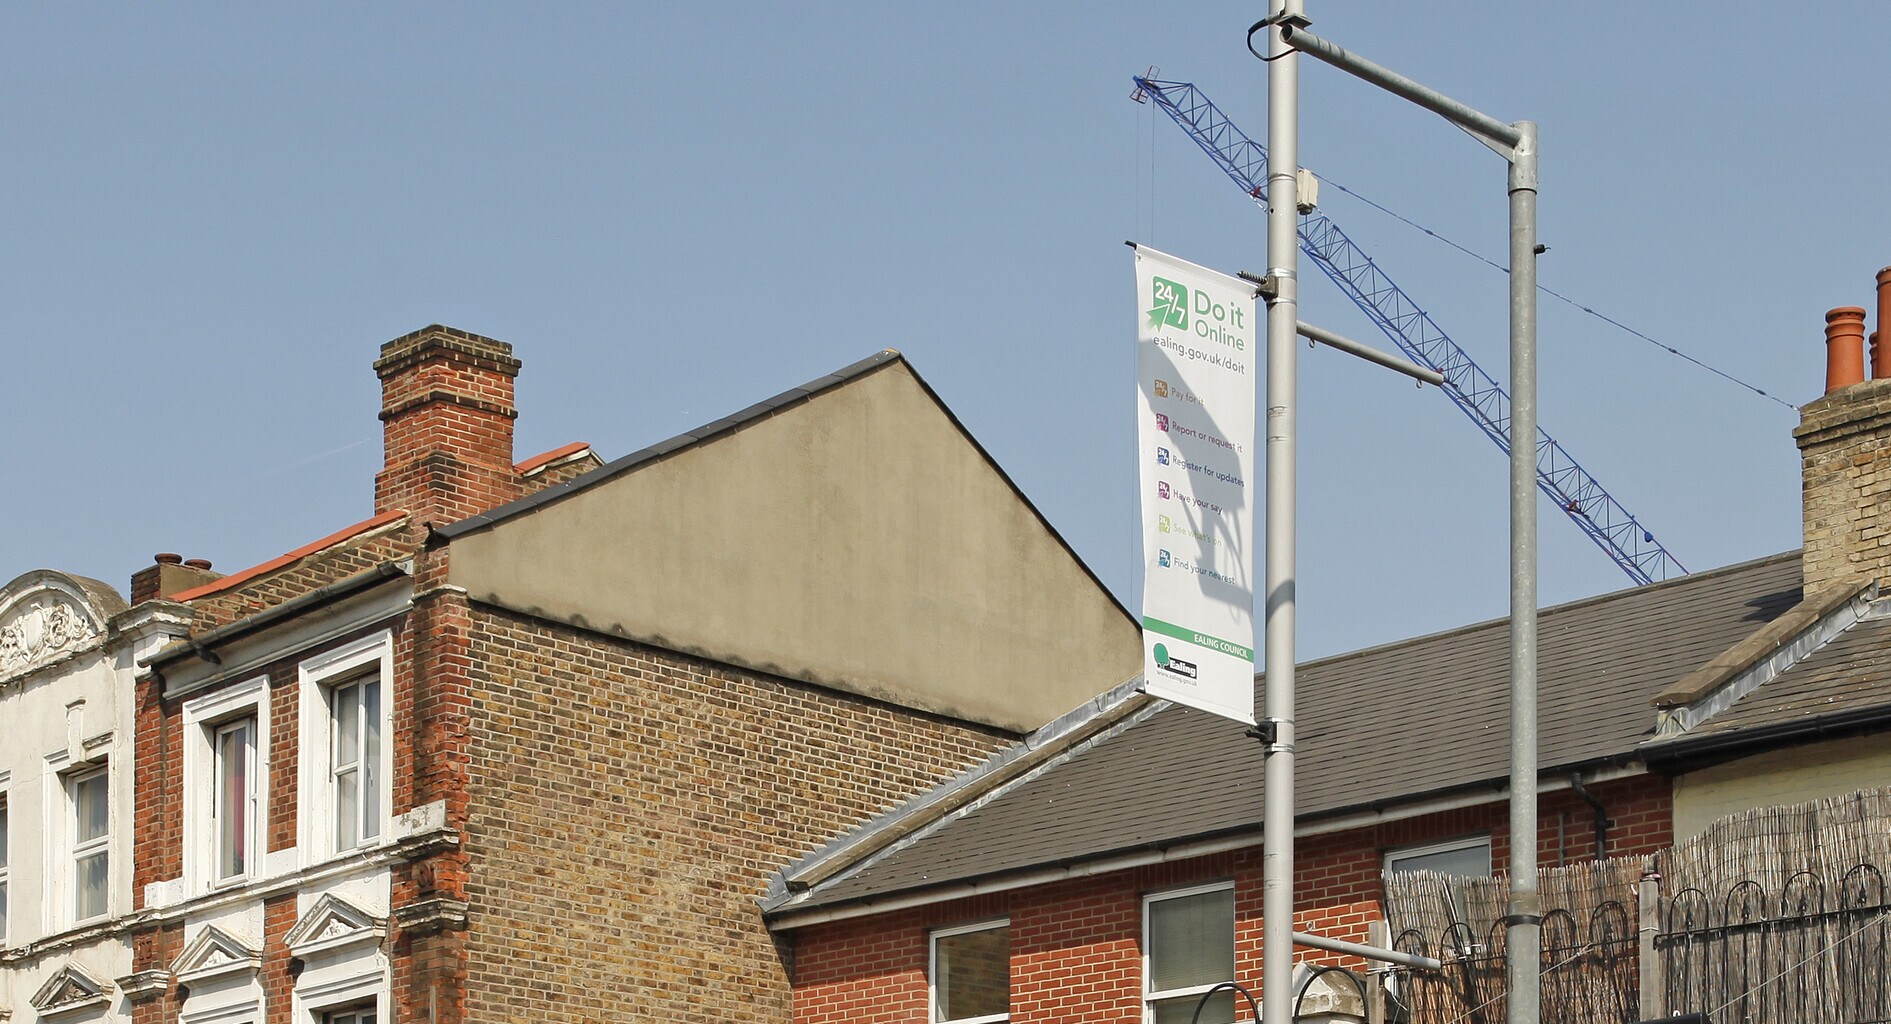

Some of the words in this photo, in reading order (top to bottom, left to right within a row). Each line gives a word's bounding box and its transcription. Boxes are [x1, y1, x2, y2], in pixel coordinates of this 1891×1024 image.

[1194, 288, 1226, 321] Do
[1230, 301, 1244, 330] it
[1195, 319, 1245, 351] Online
[1153, 336, 1245, 375] ealing.gov.uk/doit
[1171, 387, 1184, 401] Pay
[1185, 392, 1196, 404] for
[1198, 397, 1204, 406] it
[1172, 420, 1197, 438] Report
[1198, 432, 1207, 440] or
[1208, 435, 1236, 451] request
[1236, 443, 1243, 453] it
[1172, 454, 1202, 473] Register
[1204, 465, 1215, 477] for
[1215, 470, 1245, 488] updates
[1173, 489, 1191, 503] Have
[1192, 497, 1210, 509] your
[1210, 503, 1223, 515] say
[1173, 523, 1187, 537] See
[1212, 538, 1222, 546] on
[1173, 557, 1189, 571] Find
[1190, 564, 1208, 576] your
[1208, 571, 1236, 585] nearest
[1194, 633, 1219, 650] EALING
[1219, 641, 1249, 659] COUNCIL
[1169, 659, 1197, 678] Ealing
